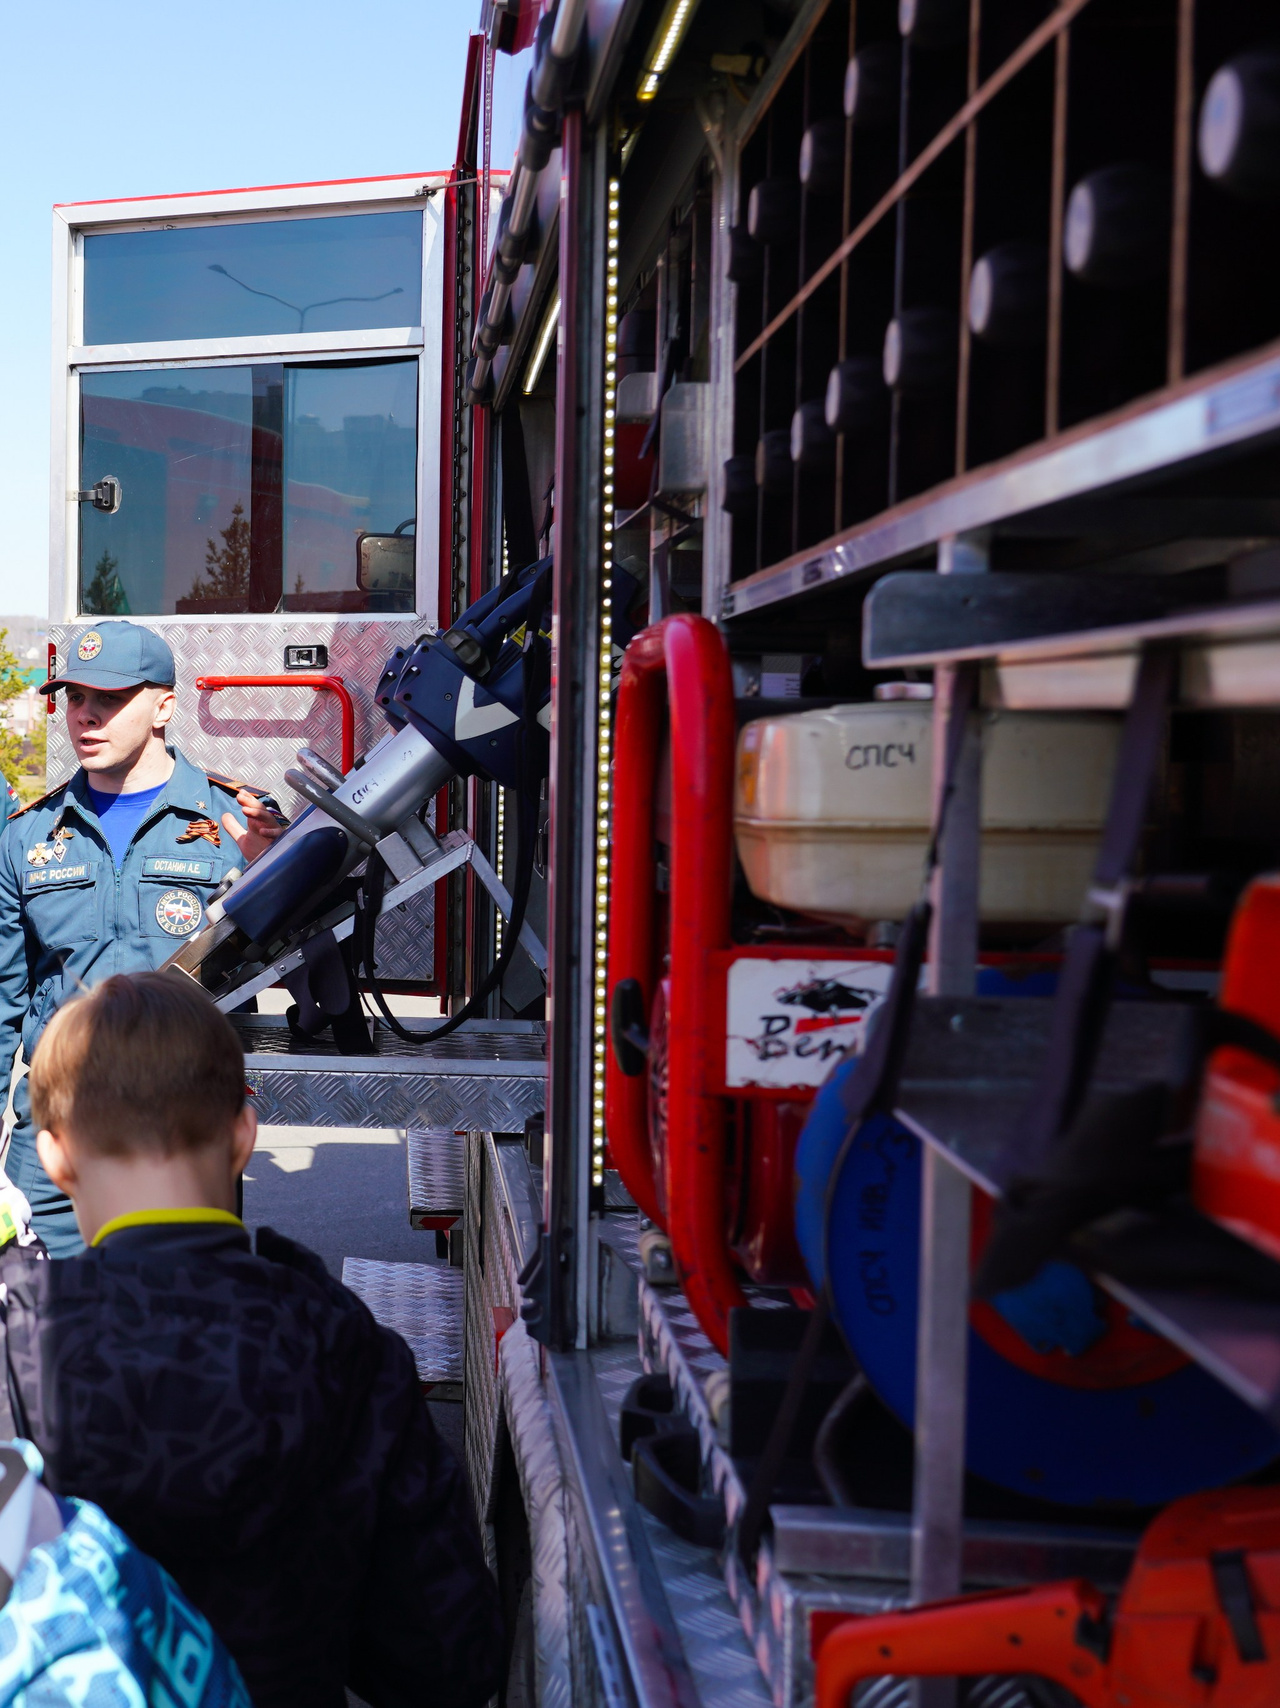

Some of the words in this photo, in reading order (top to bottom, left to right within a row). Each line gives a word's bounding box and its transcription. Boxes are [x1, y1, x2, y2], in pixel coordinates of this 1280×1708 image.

[844, 742, 916, 772] СПСЧ
[29, 869, 47, 884] МЧС
[49, 865, 85, 880] РОССИИ
[154, 860, 187, 873] ОСТАНИН
[160, 892, 176, 906] МЧС
[177, 891, 200, 914] РОССИИ
[158, 910, 198, 934] EMERCOM
